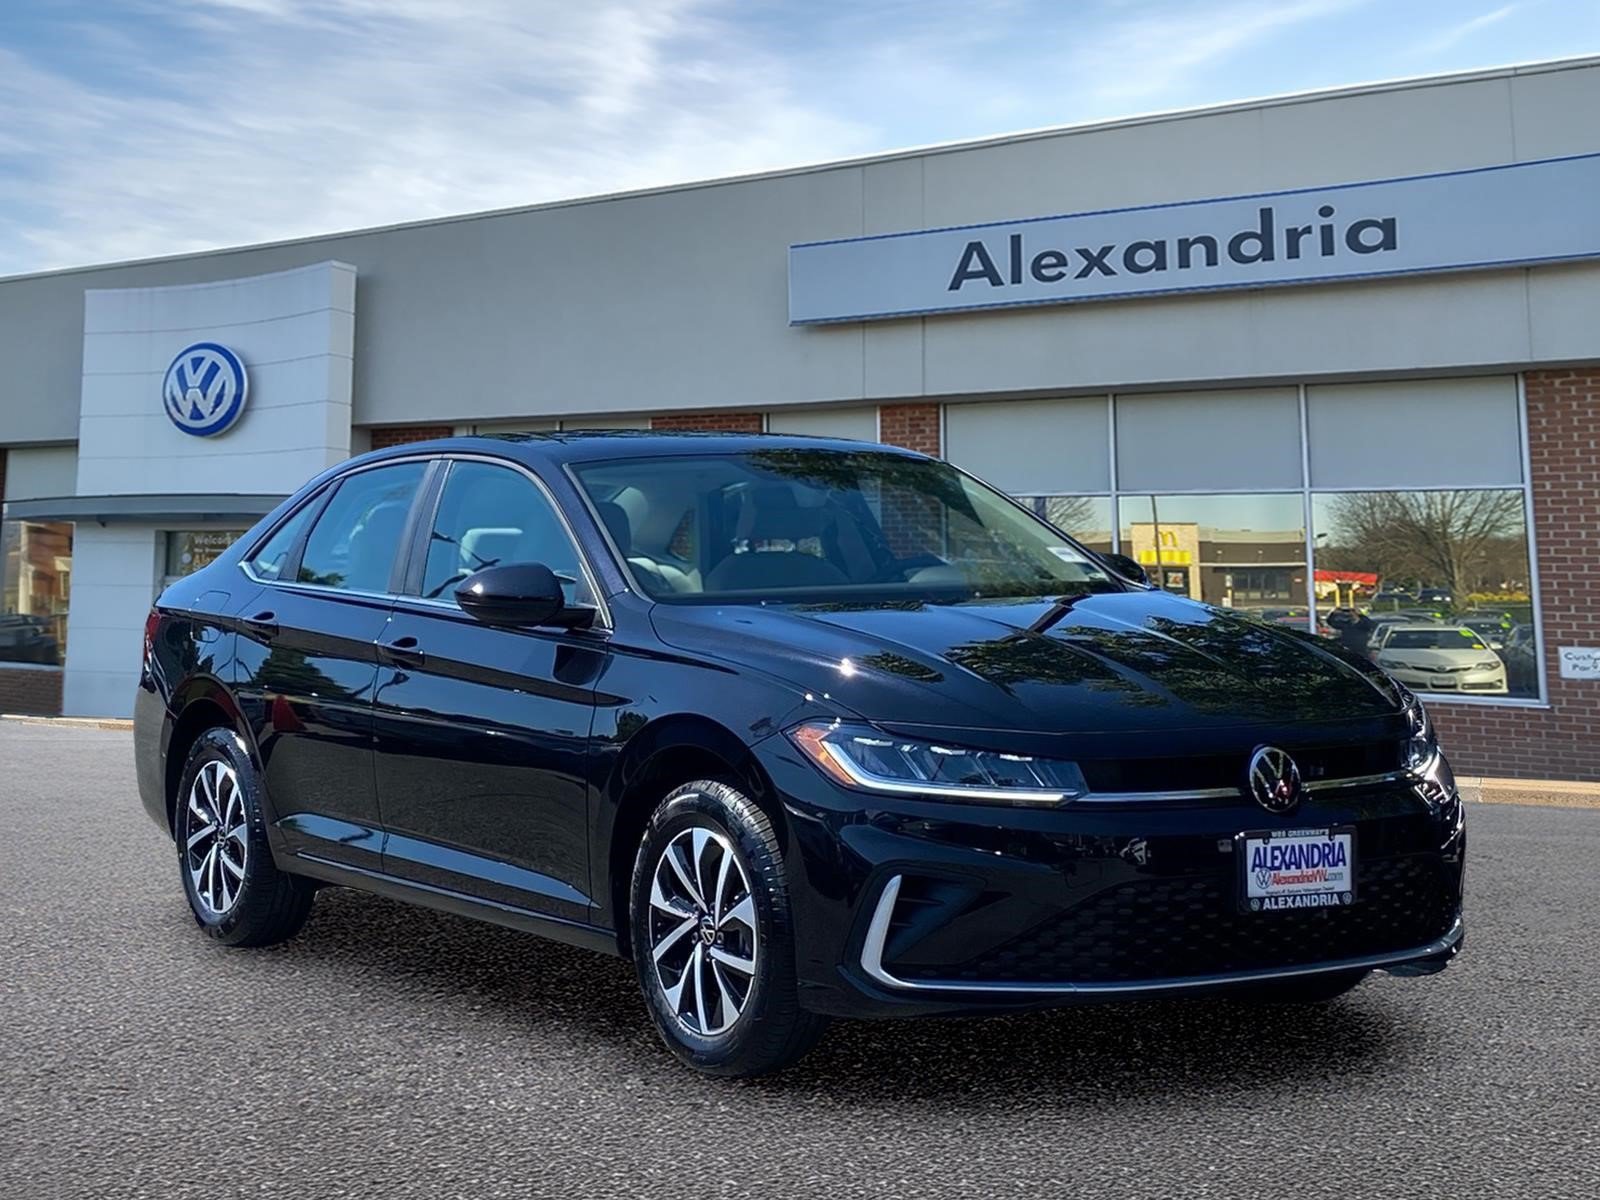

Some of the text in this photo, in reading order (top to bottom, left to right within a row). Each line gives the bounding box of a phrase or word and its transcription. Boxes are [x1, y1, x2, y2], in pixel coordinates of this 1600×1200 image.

[948, 206, 1398, 291] Alexandria
[165, 346, 240, 431] VW
[1251, 842, 1347, 873] ALEXANDRIA
[1263, 893, 1340, 910] ALEXANDRIA
